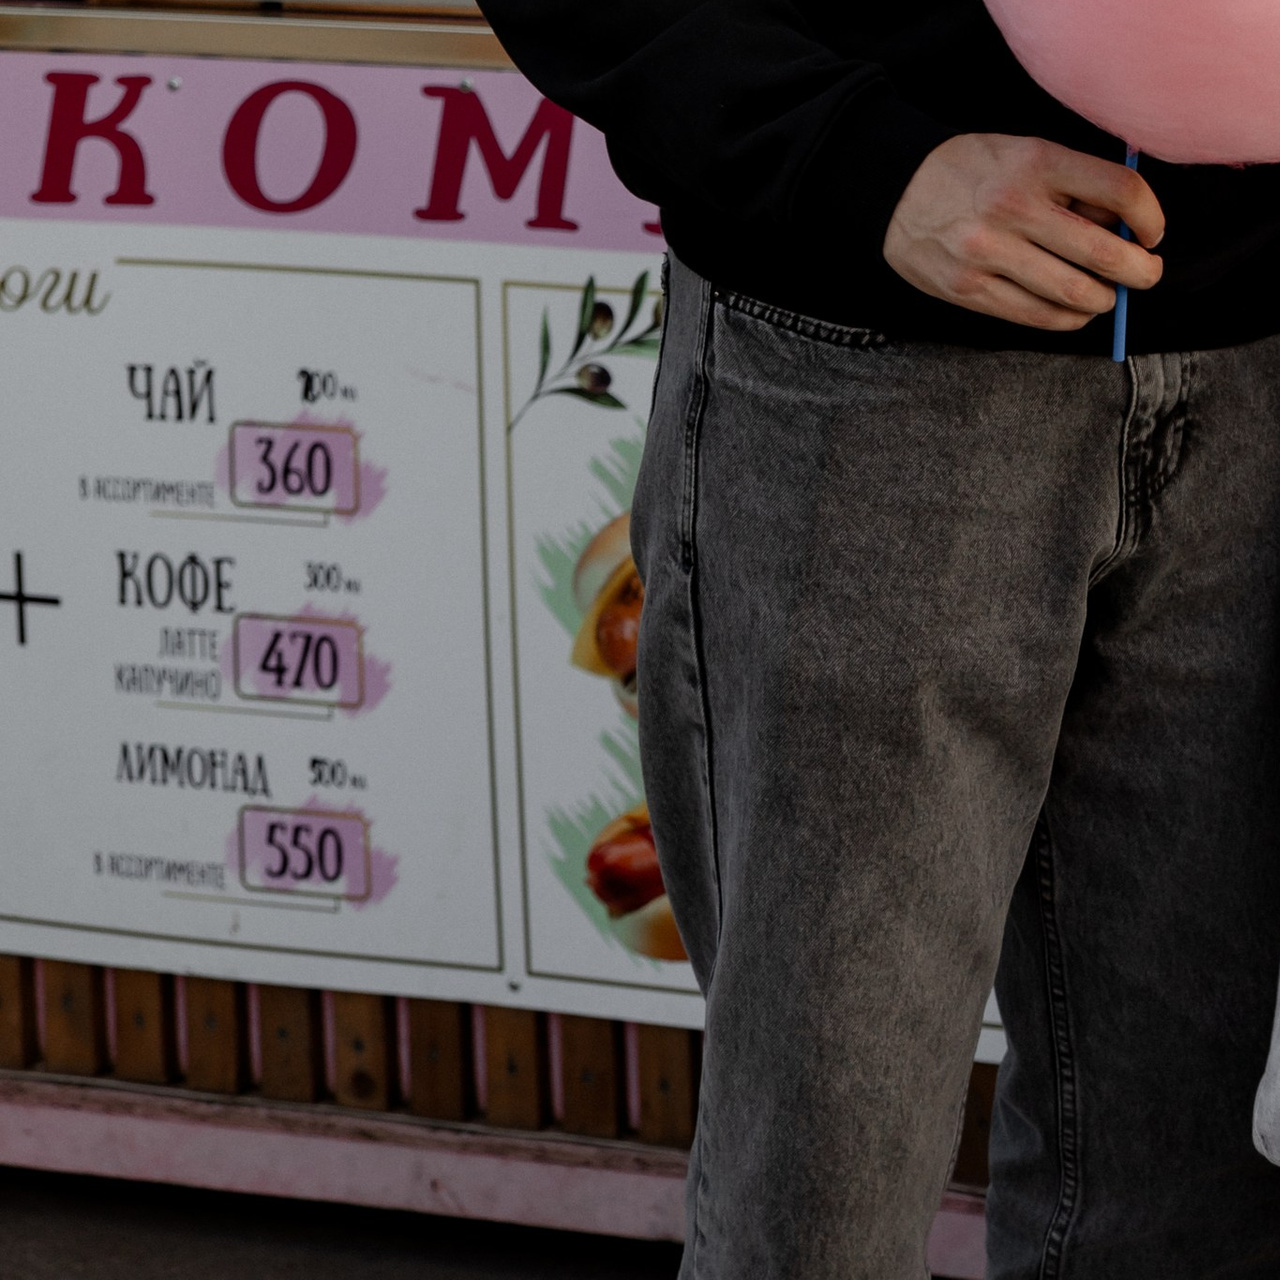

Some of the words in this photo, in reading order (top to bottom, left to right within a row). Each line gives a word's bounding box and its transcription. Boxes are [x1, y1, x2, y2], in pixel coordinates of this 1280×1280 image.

[30, 70, 663, 234] КОМ
[126, 360, 216, 422] ЧАЙ
[256, 436, 332, 496] 360
[116, 550, 237, 613] КОФЕ
[159, 628, 220, 660] ЛАТТЕ
[260, 631, 339, 691] 470
[117, 743, 272, 798] ЛИМОНАД
[266, 822, 344, 882] 550
